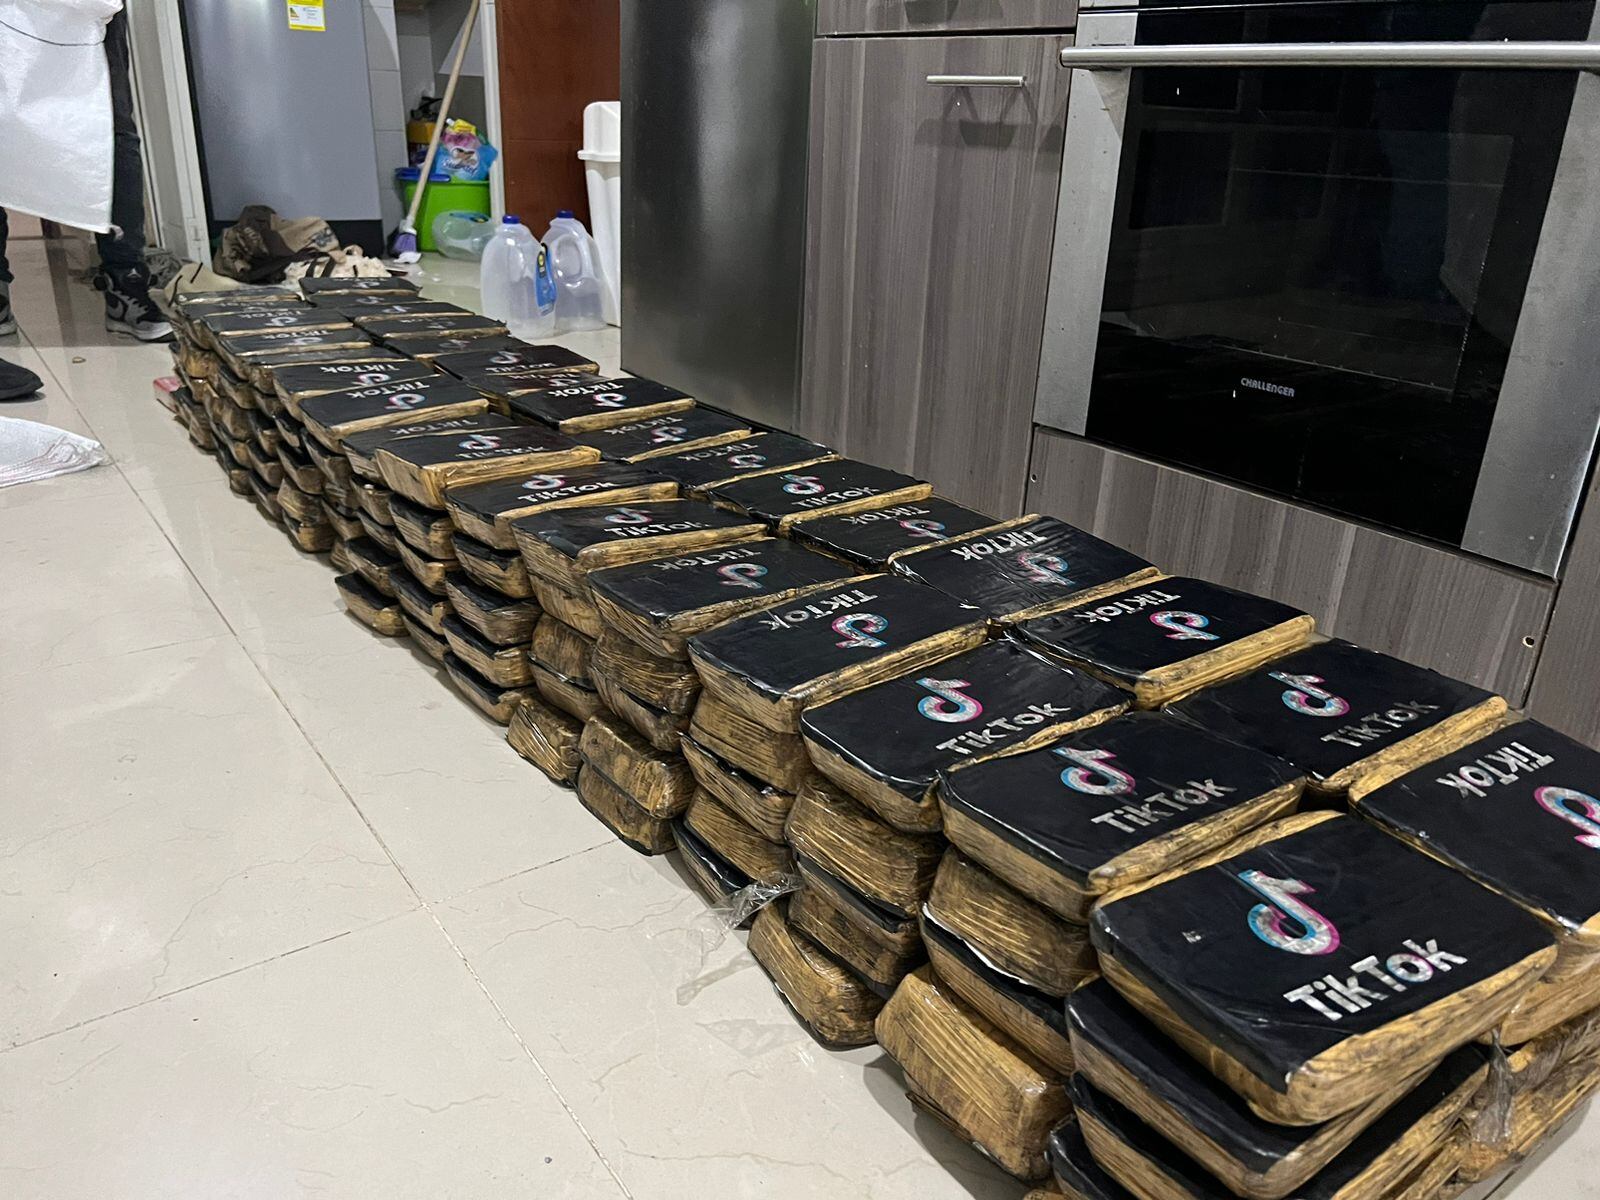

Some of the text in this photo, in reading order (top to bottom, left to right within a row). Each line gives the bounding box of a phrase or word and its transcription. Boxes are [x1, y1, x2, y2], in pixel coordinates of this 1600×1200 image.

[320, 364, 400, 373] TikTok
[347, 381, 430, 399] TikTok
[548, 381, 624, 398] TikTok
[1240, 377, 1295, 397] CHALLENGER
[389, 419, 478, 435] TikTok
[604, 416, 683, 435] TikTok
[677, 443, 759, 461] TikTok
[518, 481, 621, 503] TikTok
[791, 486, 880, 508] TikTok
[840, 506, 930, 525] TikTok
[951, 530, 1048, 560] TikTok
[652, 548, 762, 571] TikTok
[758, 589, 878, 631] TikTok
[1074, 589, 1181, 623] TikTok
[936, 702, 1071, 755] TikTok
[1320, 700, 1440, 746] TikTok
[1435, 741, 1555, 799] TikTok
[1091, 778, 1237, 833] TikTok
[1283, 938, 1468, 1022] TikTok
